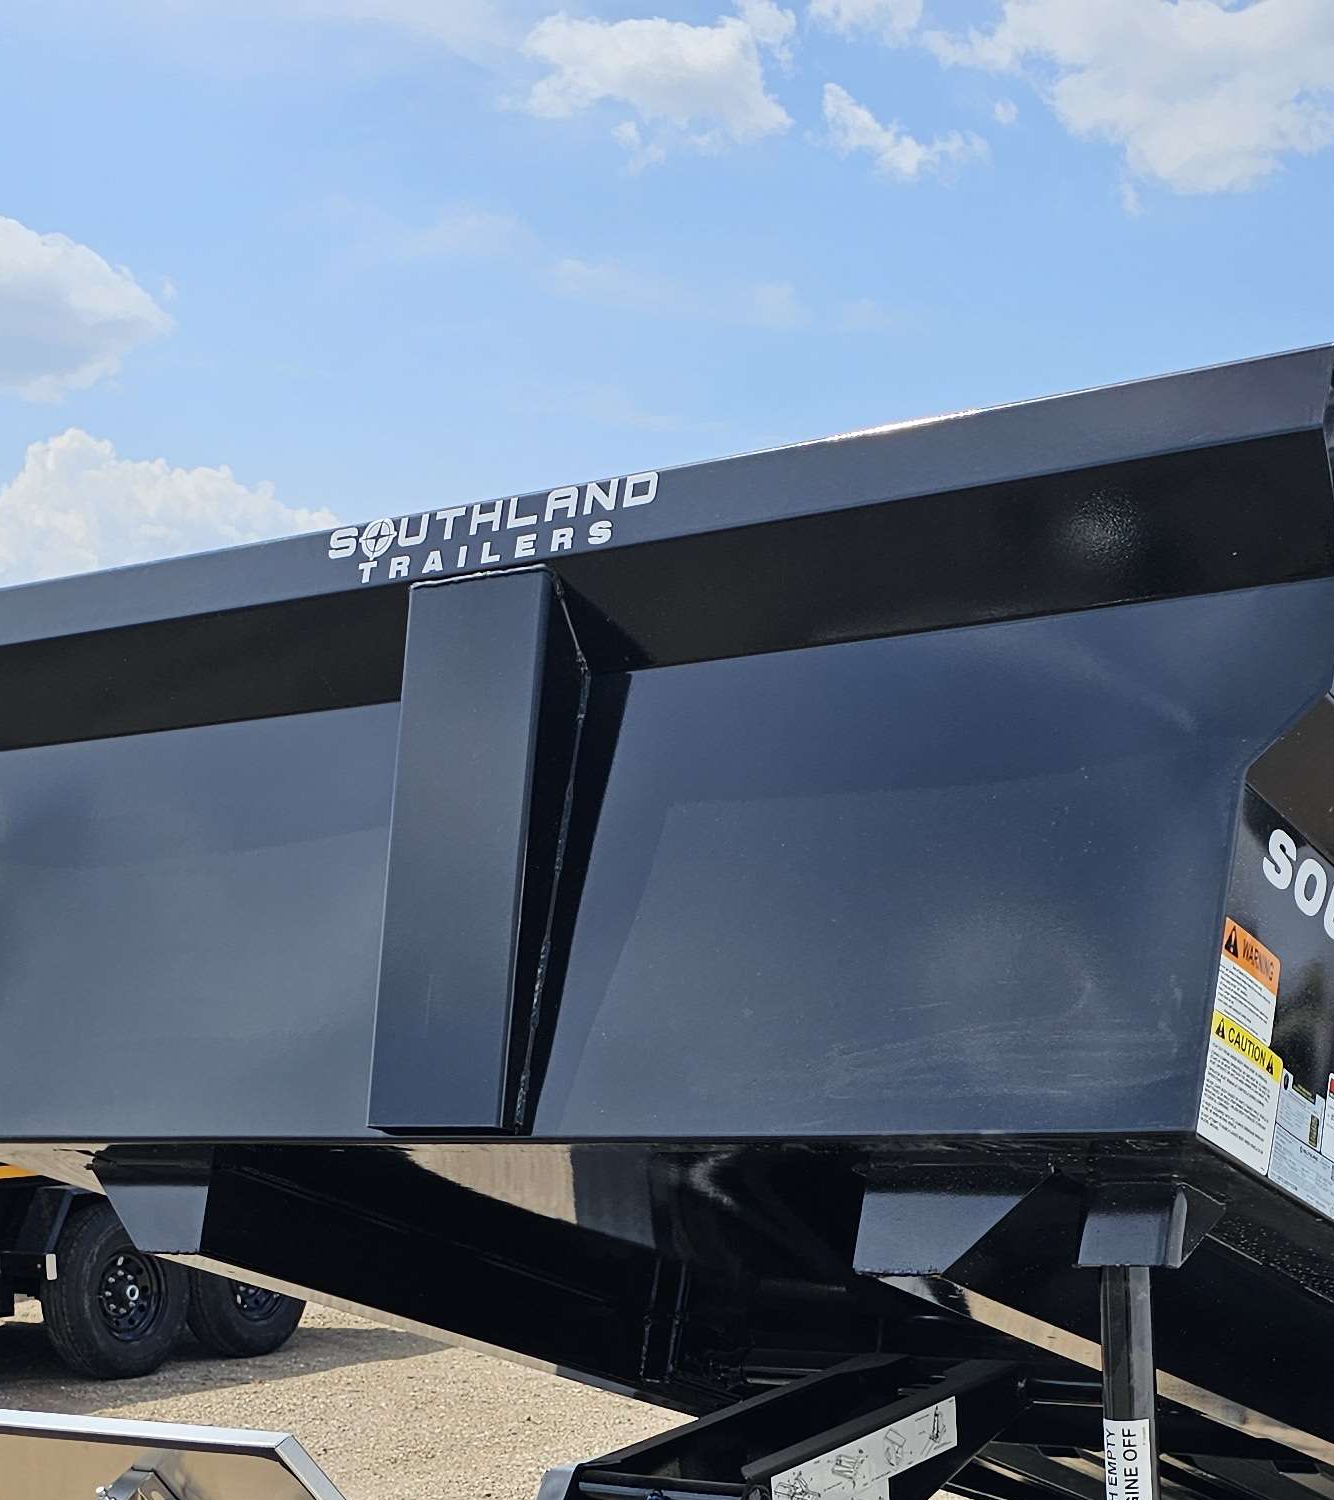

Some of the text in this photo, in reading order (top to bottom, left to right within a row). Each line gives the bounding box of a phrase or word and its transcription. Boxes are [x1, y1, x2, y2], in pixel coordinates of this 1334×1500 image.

[328, 471, 659, 561] SOUTHLAND
[358, 520, 613, 583] TRAILERS
[1242, 938, 1274, 981] WARNING
[1228, 1027, 1266, 1067] CAUTION
[1105, 1428, 1119, 1485] EMPTY
[1121, 1428, 1138, 1462] OFF
